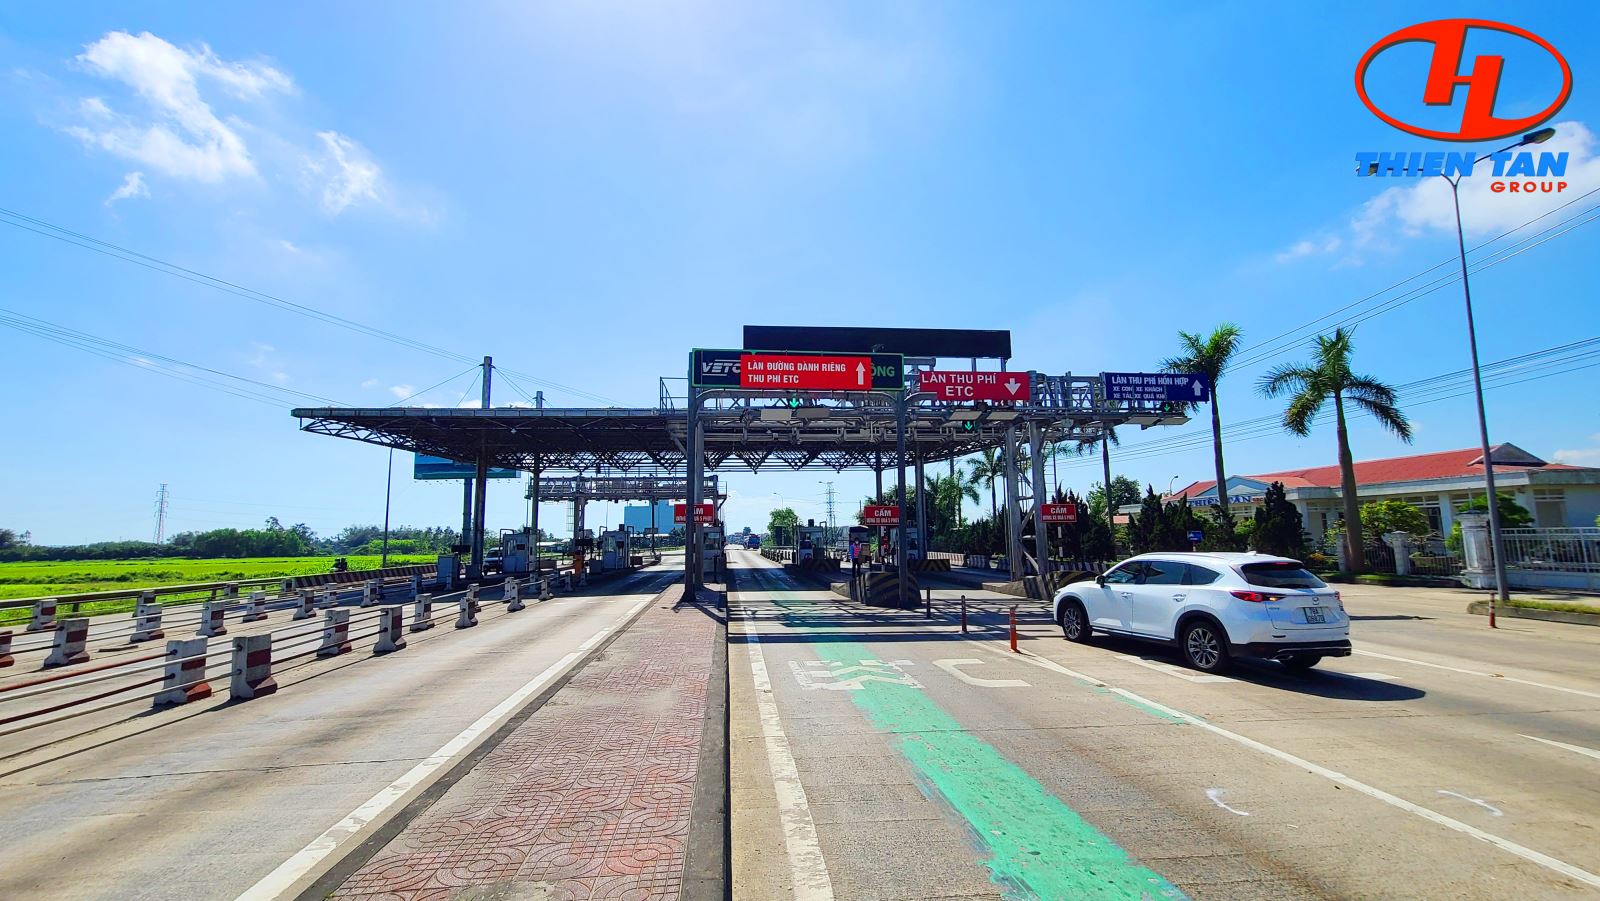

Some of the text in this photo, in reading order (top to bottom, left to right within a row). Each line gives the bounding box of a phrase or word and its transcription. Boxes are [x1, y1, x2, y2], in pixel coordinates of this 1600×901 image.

[748, 359, 764, 371] LÀN
[767, 360, 795, 371] ĐƯỜNG
[822, 361, 846, 372] RIÊNG
[748, 373, 800, 384] THU PHÍ ETC
[922, 372, 997, 384] LÀN THU PHÍ
[1112, 374, 1127, 384] LÀN
[1128, 376, 1142, 384] THU
[1144, 376, 1156, 385] PHÍ
[945, 385, 974, 397] ETC
[874, 507, 892, 517] CẤM
